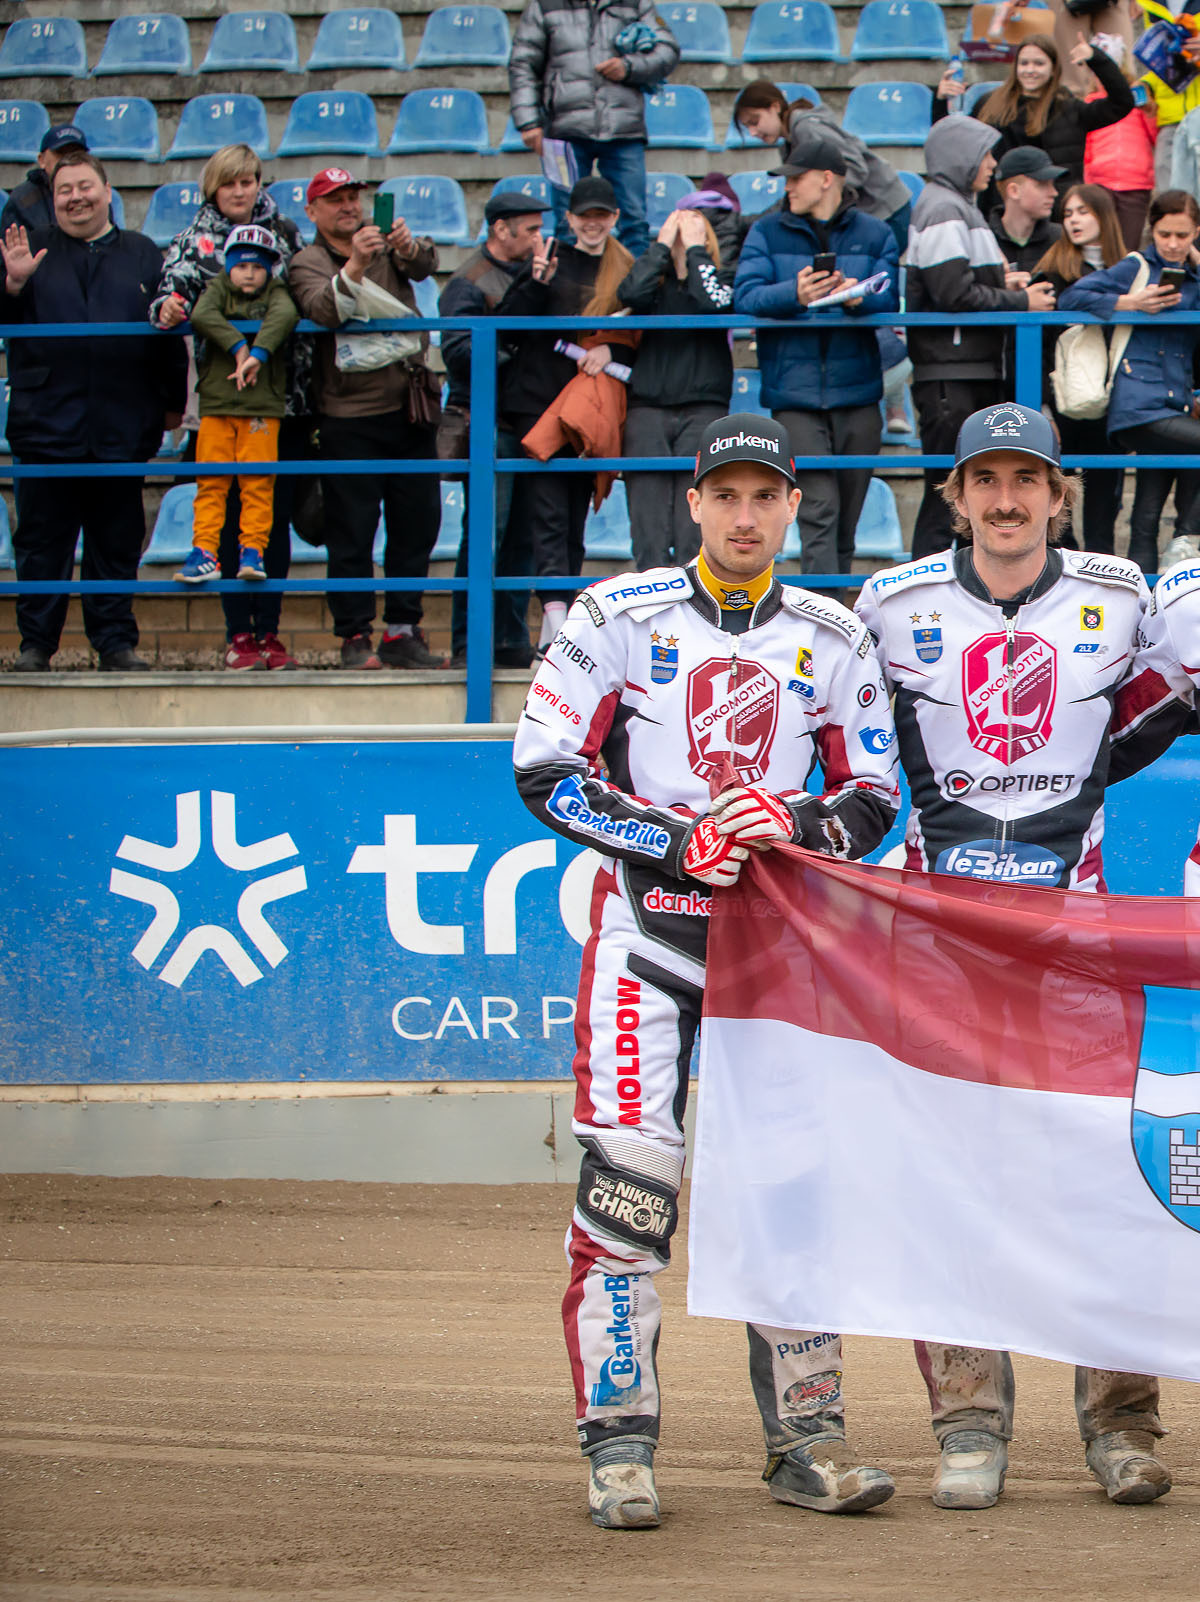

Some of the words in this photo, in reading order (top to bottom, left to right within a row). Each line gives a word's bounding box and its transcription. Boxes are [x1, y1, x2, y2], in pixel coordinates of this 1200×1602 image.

[137, 19, 161, 36] 37
[105, 103, 129, 121] 37
[709, 431, 780, 455] dankemi
[872, 562, 948, 593] TRODO
[1069, 554, 1142, 582] Interio
[605, 577, 687, 602] TRODO
[790, 589, 858, 635] Interio
[971, 646, 1045, 708] LOKOMOTIV
[533, 682, 562, 707] emi
[695, 676, 768, 733] LOKOMOTIV
[979, 774, 1076, 794] OPTIBET
[646, 888, 712, 916] danke
[391, 995, 522, 1042] CAR
[616, 976, 643, 1127] MOLDOW
[594, 1174, 616, 1192] Vejle
[614, 1181, 667, 1214] NIKKEL
[588, 1186, 670, 1237] CHROM
[604, 1273, 635, 1377] BarkerB
